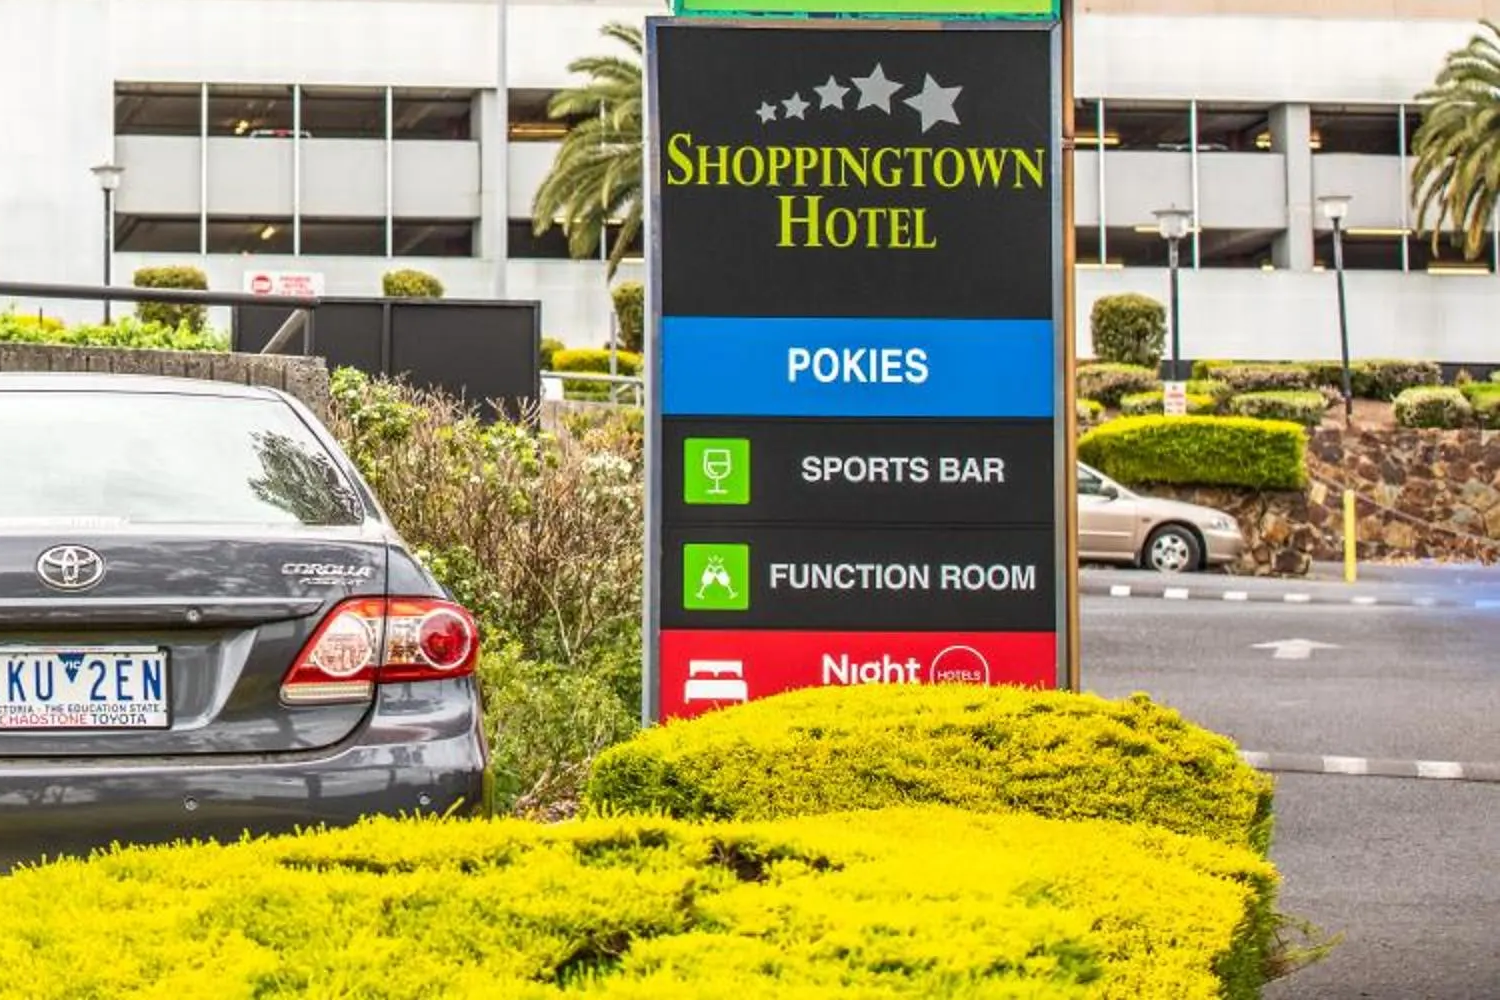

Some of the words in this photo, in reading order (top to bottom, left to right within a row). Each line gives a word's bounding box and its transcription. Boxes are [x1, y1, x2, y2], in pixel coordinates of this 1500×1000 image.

[788, 347, 929, 384] POKIES
[802, 456, 930, 482] SPORTS
[939, 457, 1005, 483] BAR
[281, 563, 375, 577] COROLLA
[769, 563, 930, 590] FUNCTION
[940, 564, 1036, 591] ROOM
[88, 659, 161, 702] 2EN
[821, 653, 920, 685] Night
[937, 670, 981, 681] HOTELS
[0, 713, 87, 726] CHADSTONE
[91, 713, 147, 725] TOYOTA
[44, 703, 64, 713] THE
[67, 703, 126, 714] EDUCATION
[129, 702, 160, 713] STATE
